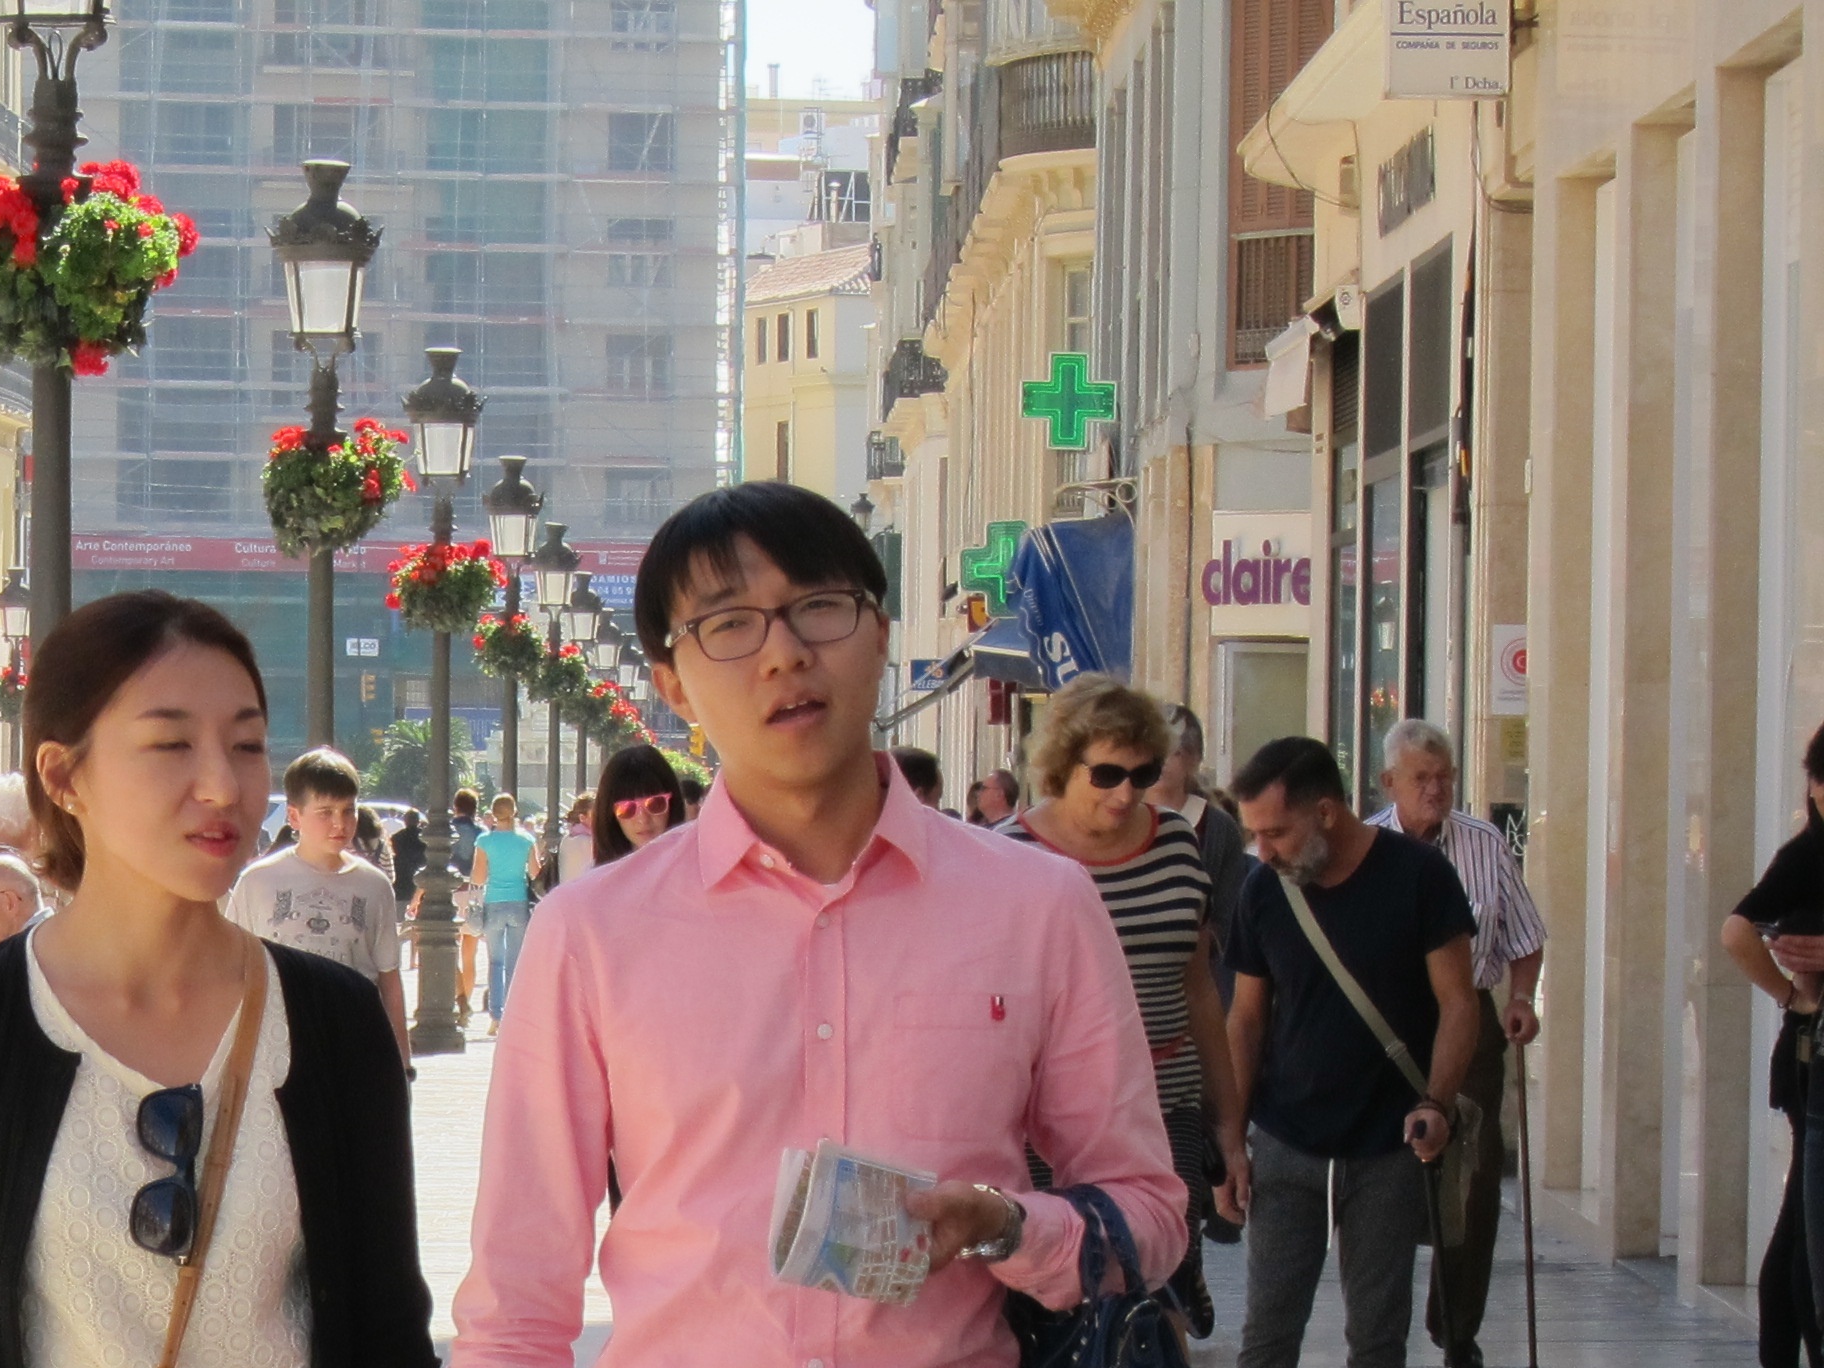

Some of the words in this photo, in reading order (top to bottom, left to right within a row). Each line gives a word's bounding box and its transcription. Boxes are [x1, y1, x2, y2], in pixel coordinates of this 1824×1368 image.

[1398, 0, 1498, 30] Española
[1446, 41, 1456, 50] DE
[1462, 41, 1499, 50] SEGUROS
[76, 540, 100, 551] Arte
